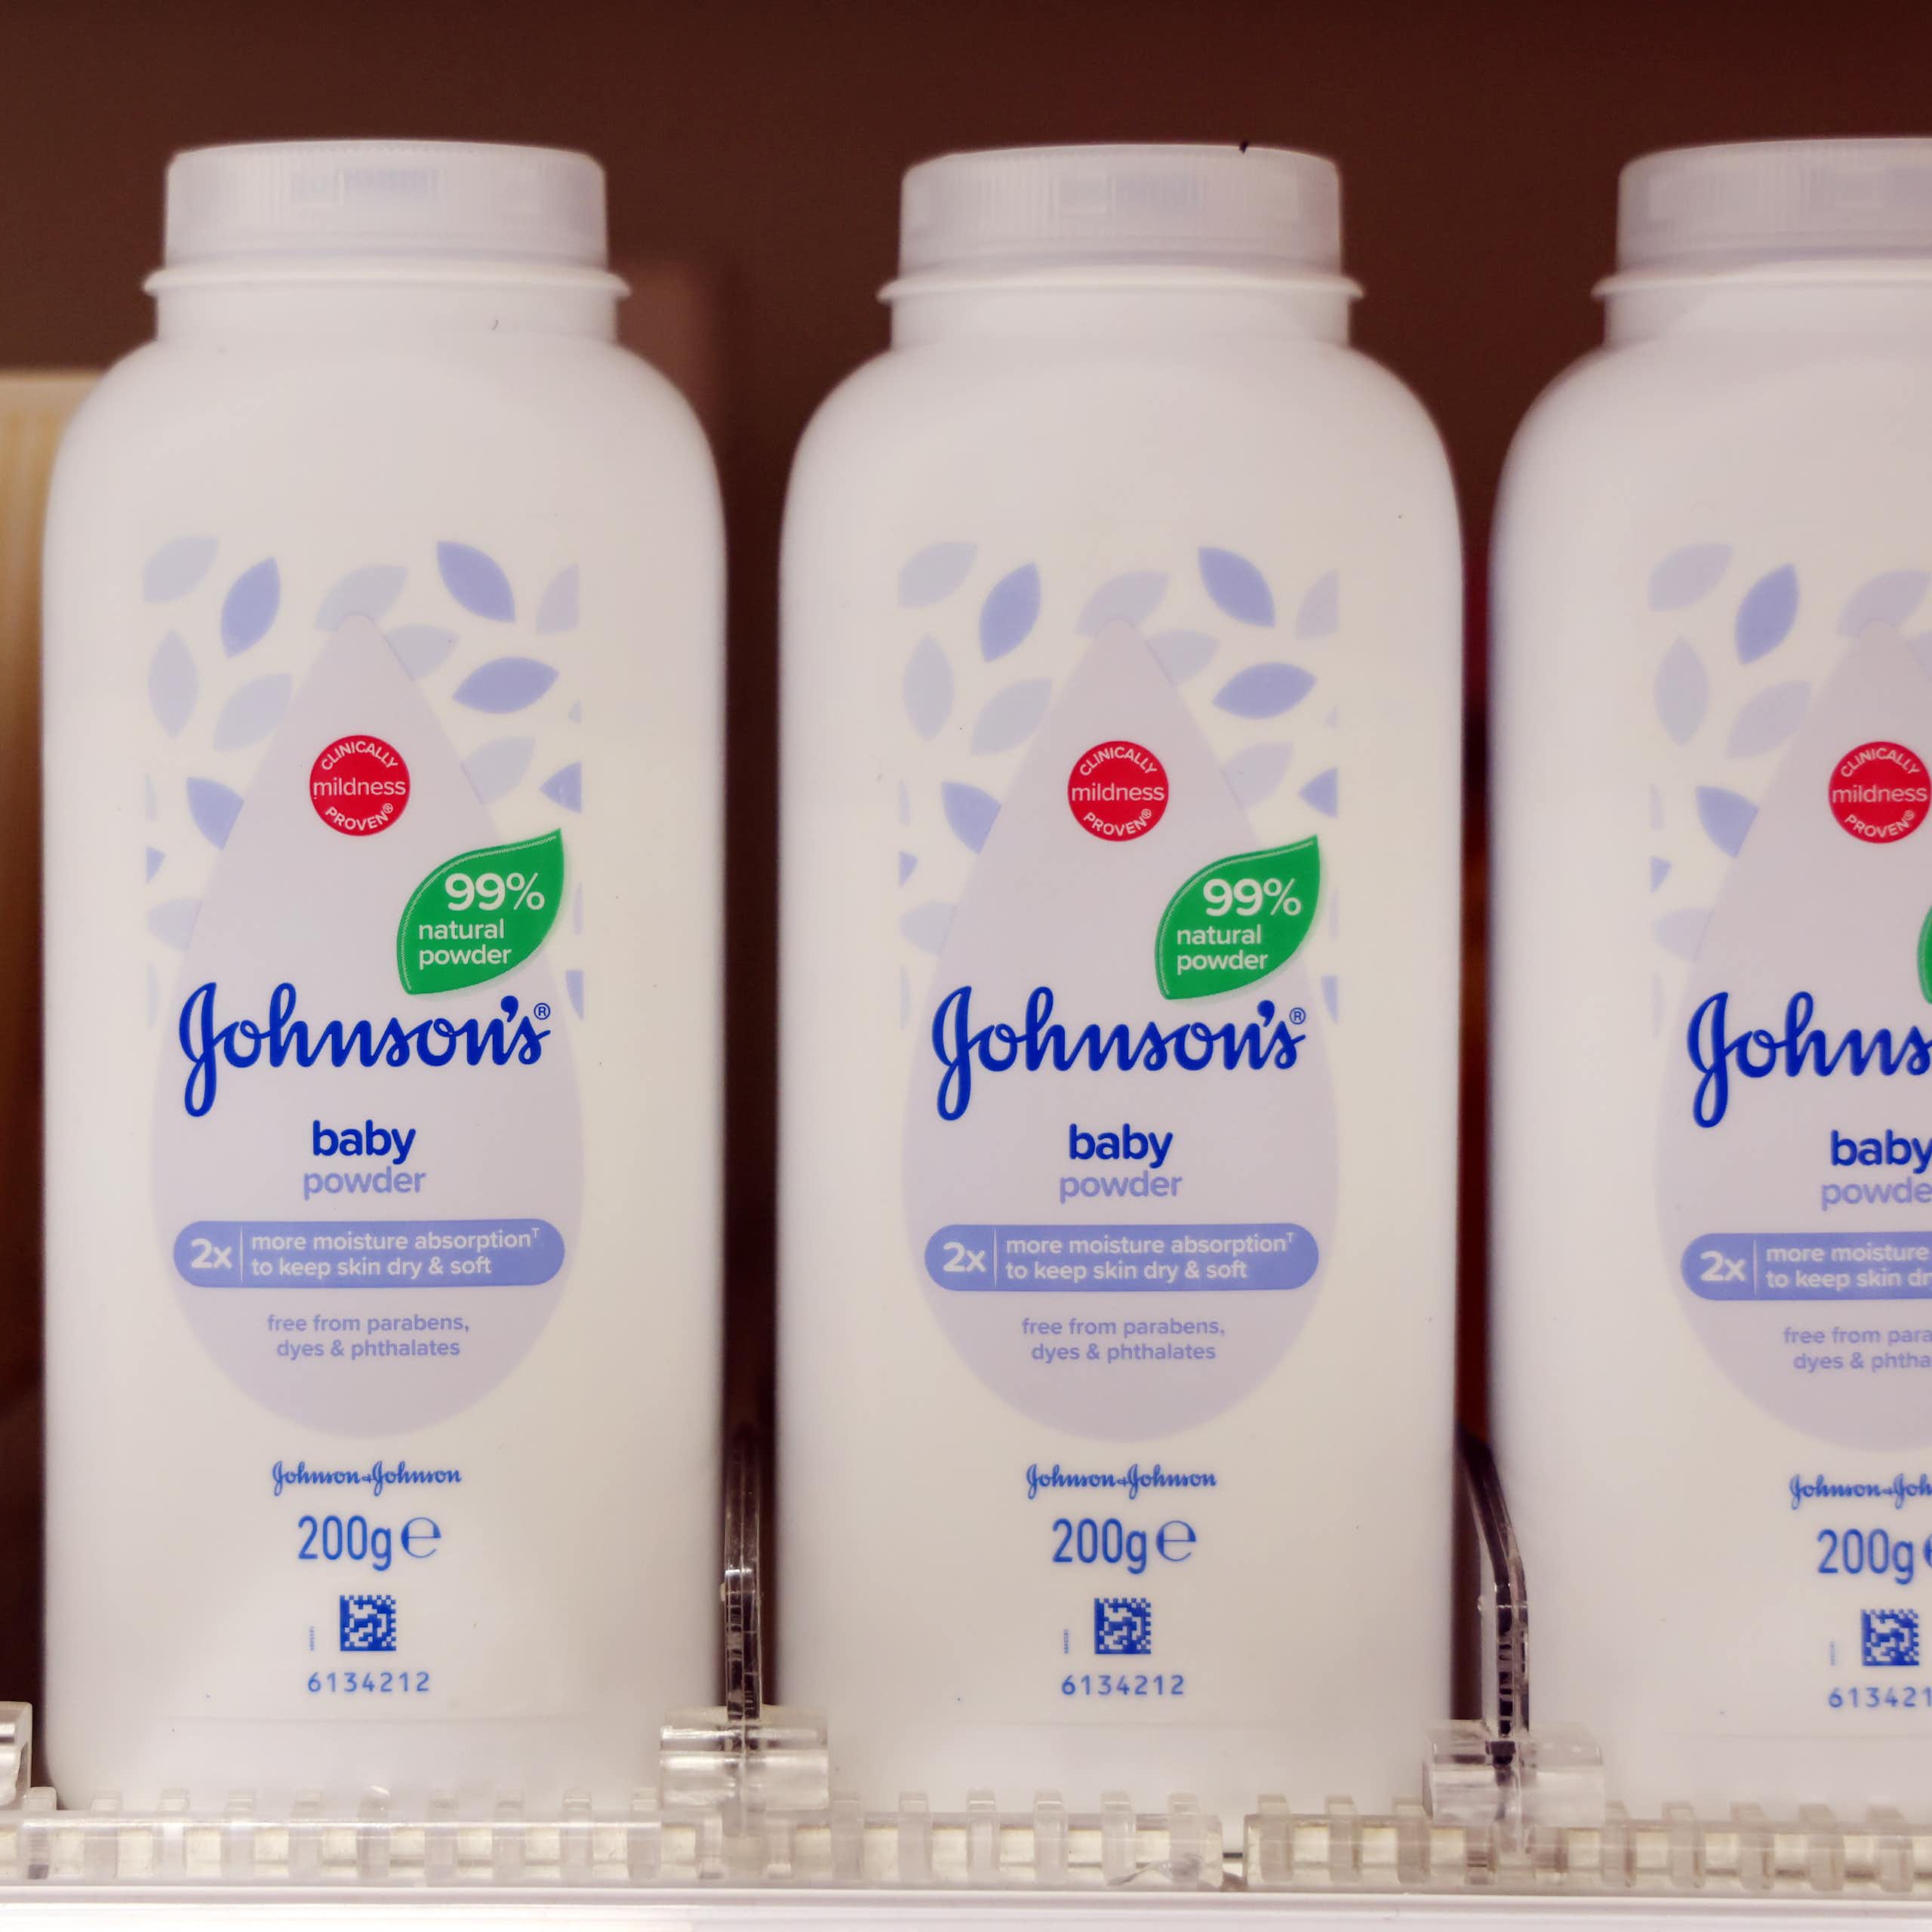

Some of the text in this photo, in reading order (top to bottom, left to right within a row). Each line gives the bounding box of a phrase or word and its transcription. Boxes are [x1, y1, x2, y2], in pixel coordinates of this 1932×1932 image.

[321, 740, 398, 771] CLINICALLY
[1079, 746, 1158, 776] CLINICALLY
[1840, 747, 1921, 777] CLINICALLY
[313, 777, 406, 795] mildness
[1072, 783, 1164, 801] mildness
[1832, 785, 1928, 804] mildness
[445, 872, 545, 911] 99%
[1203, 878, 1301, 916] 99%
[419, 918, 503, 940] natural
[1177, 924, 1261, 945] natural
[419, 945, 512, 970] powder
[1177, 949, 1269, 975] powder
[313, 1120, 416, 1164] baby
[1069, 1124, 1173, 1169] baby
[304, 1166, 426, 1201] powder
[1060, 1170, 1183, 1203] powder
[252, 1236, 306, 1251] more
[313, 1231, 408, 1250] moisture
[1007, 1240, 1063, 1254] more
[1069, 1235, 1164, 1254] moisture
[1767, 1242, 1930, 1262] more moisture
[191, 1238, 232, 1269] 2x
[943, 1242, 986, 1272] 2x
[251, 1256, 491, 1280] to keep skin dry & soft
[1005, 1259, 1247, 1283] to keep skin dry & soft
[1701, 1251, 1746, 1281] 2x
[1765, 1270, 1790, 1287] to
[1795, 1269, 1850, 1291] keep
[1857, 1268, 1901, 1287] skin
[267, 1314, 469, 1335] free from parabens,
[1022, 1318, 1224, 1339] free from parabens,
[1783, 1327, 1826, 1344] free
[1832, 1326, 1881, 1343] from
[277, 1340, 460, 1361] dyes & phthalates
[1031, 1343, 1216, 1364] dyes & phthalates
[1794, 1353, 1844, 1374] dyes
[1850, 1352, 1864, 1369] &
[298, 1515, 392, 1571] 200g
[1053, 1518, 1146, 1574] 200g
[1818, 1529, 1914, 1585] 200g
[308, 1672, 429, 1692] 6134212
[1062, 1675, 1183, 1695] 6134212
